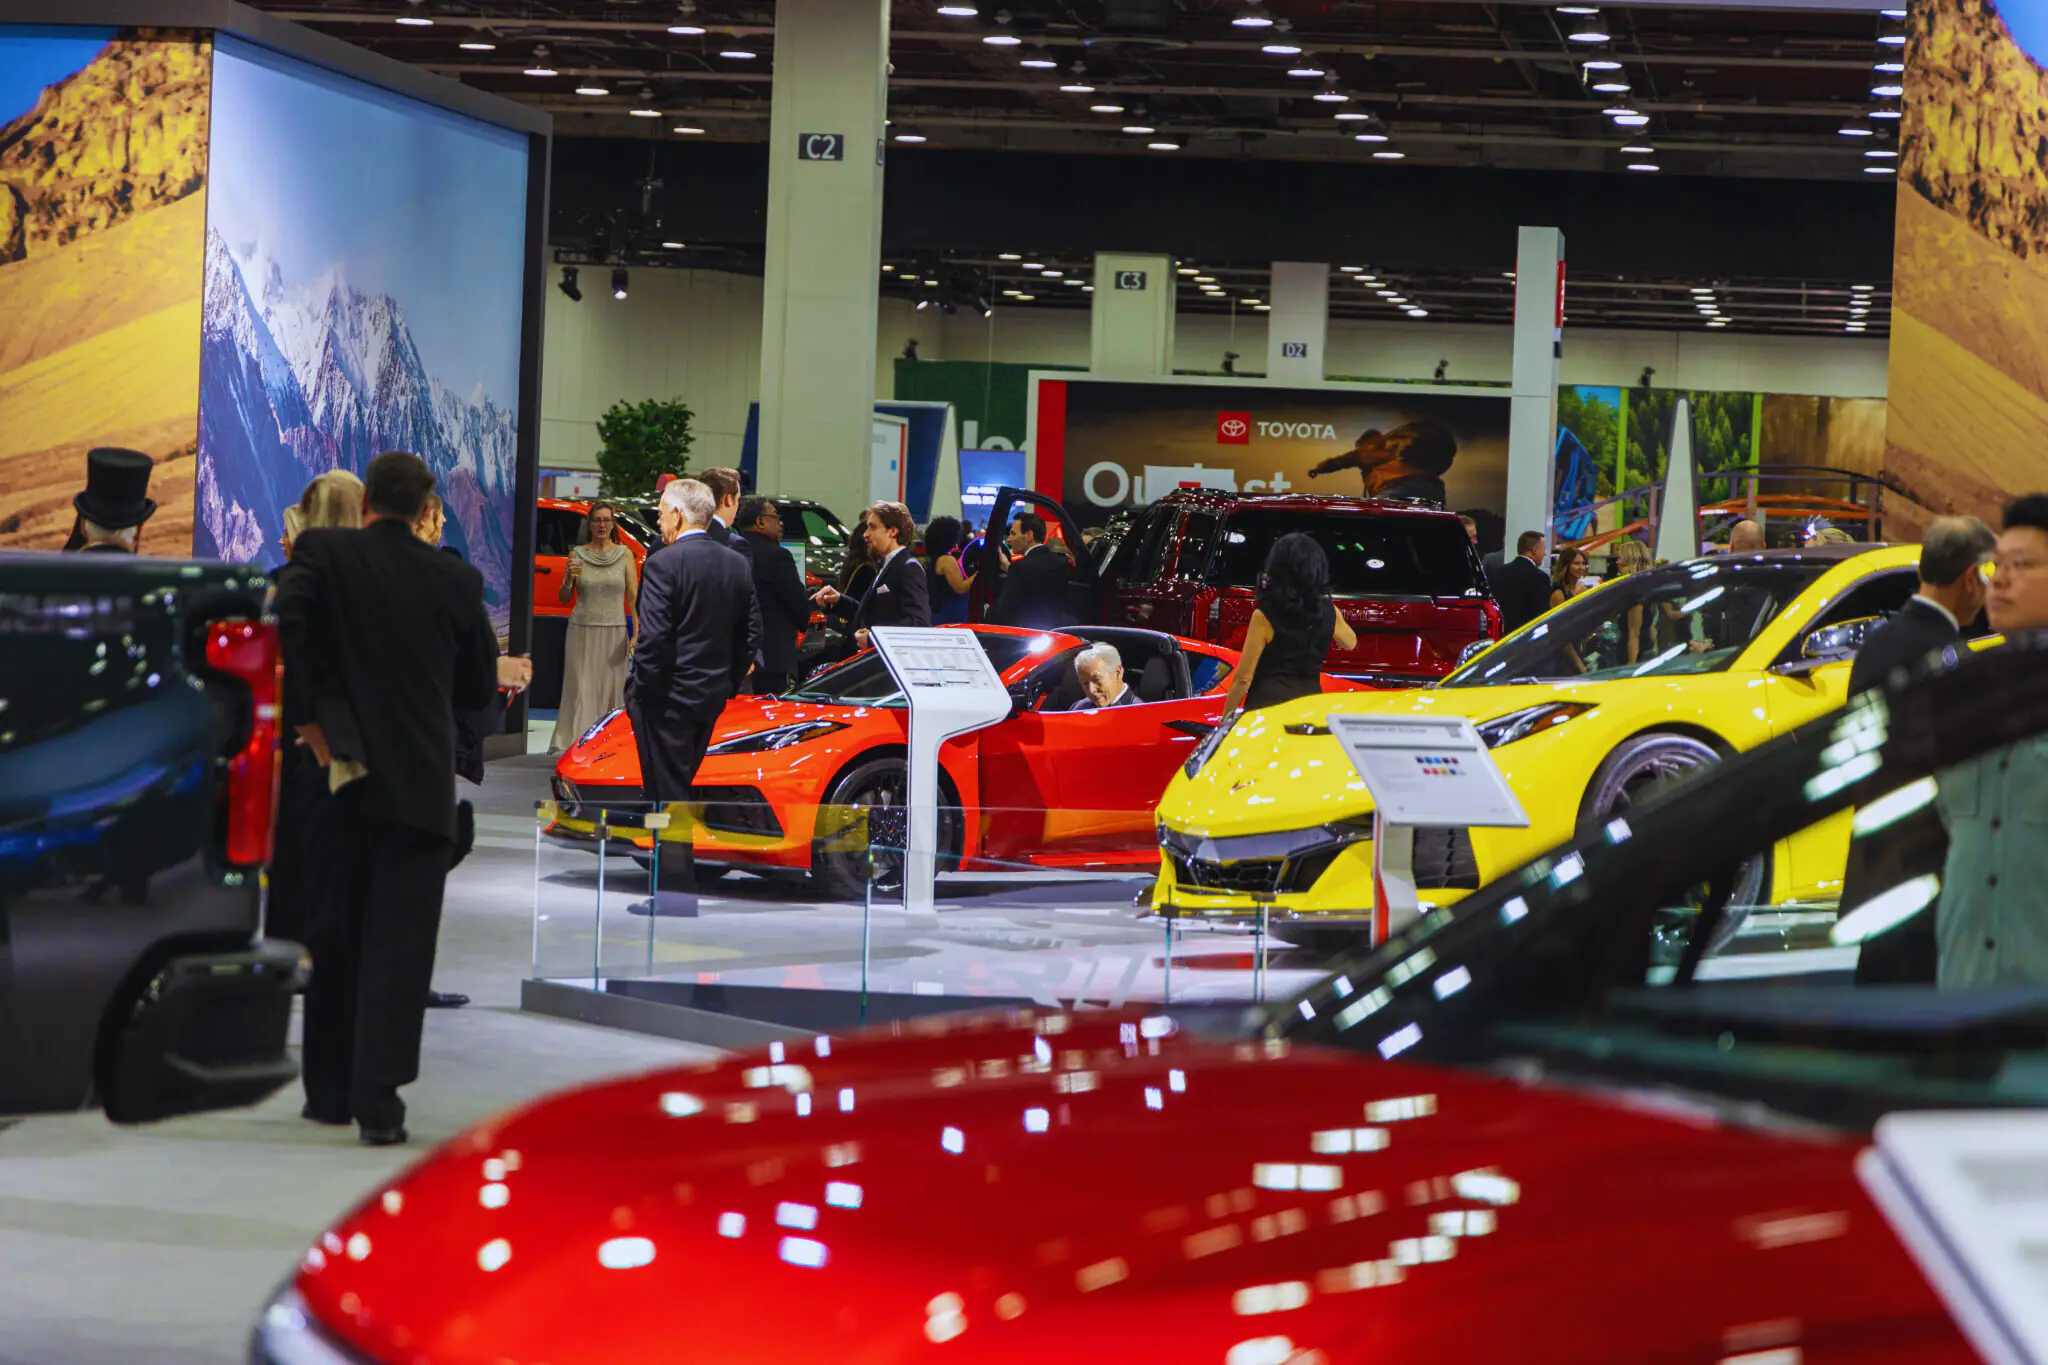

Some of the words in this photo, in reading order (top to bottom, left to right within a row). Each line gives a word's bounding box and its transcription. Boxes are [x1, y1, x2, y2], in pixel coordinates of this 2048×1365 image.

[806, 134, 836, 159] C2
[1120, 272, 1141, 289] C3
[1286, 343, 1304, 357] D2
[1257, 421, 1337, 440] TOYOTA
